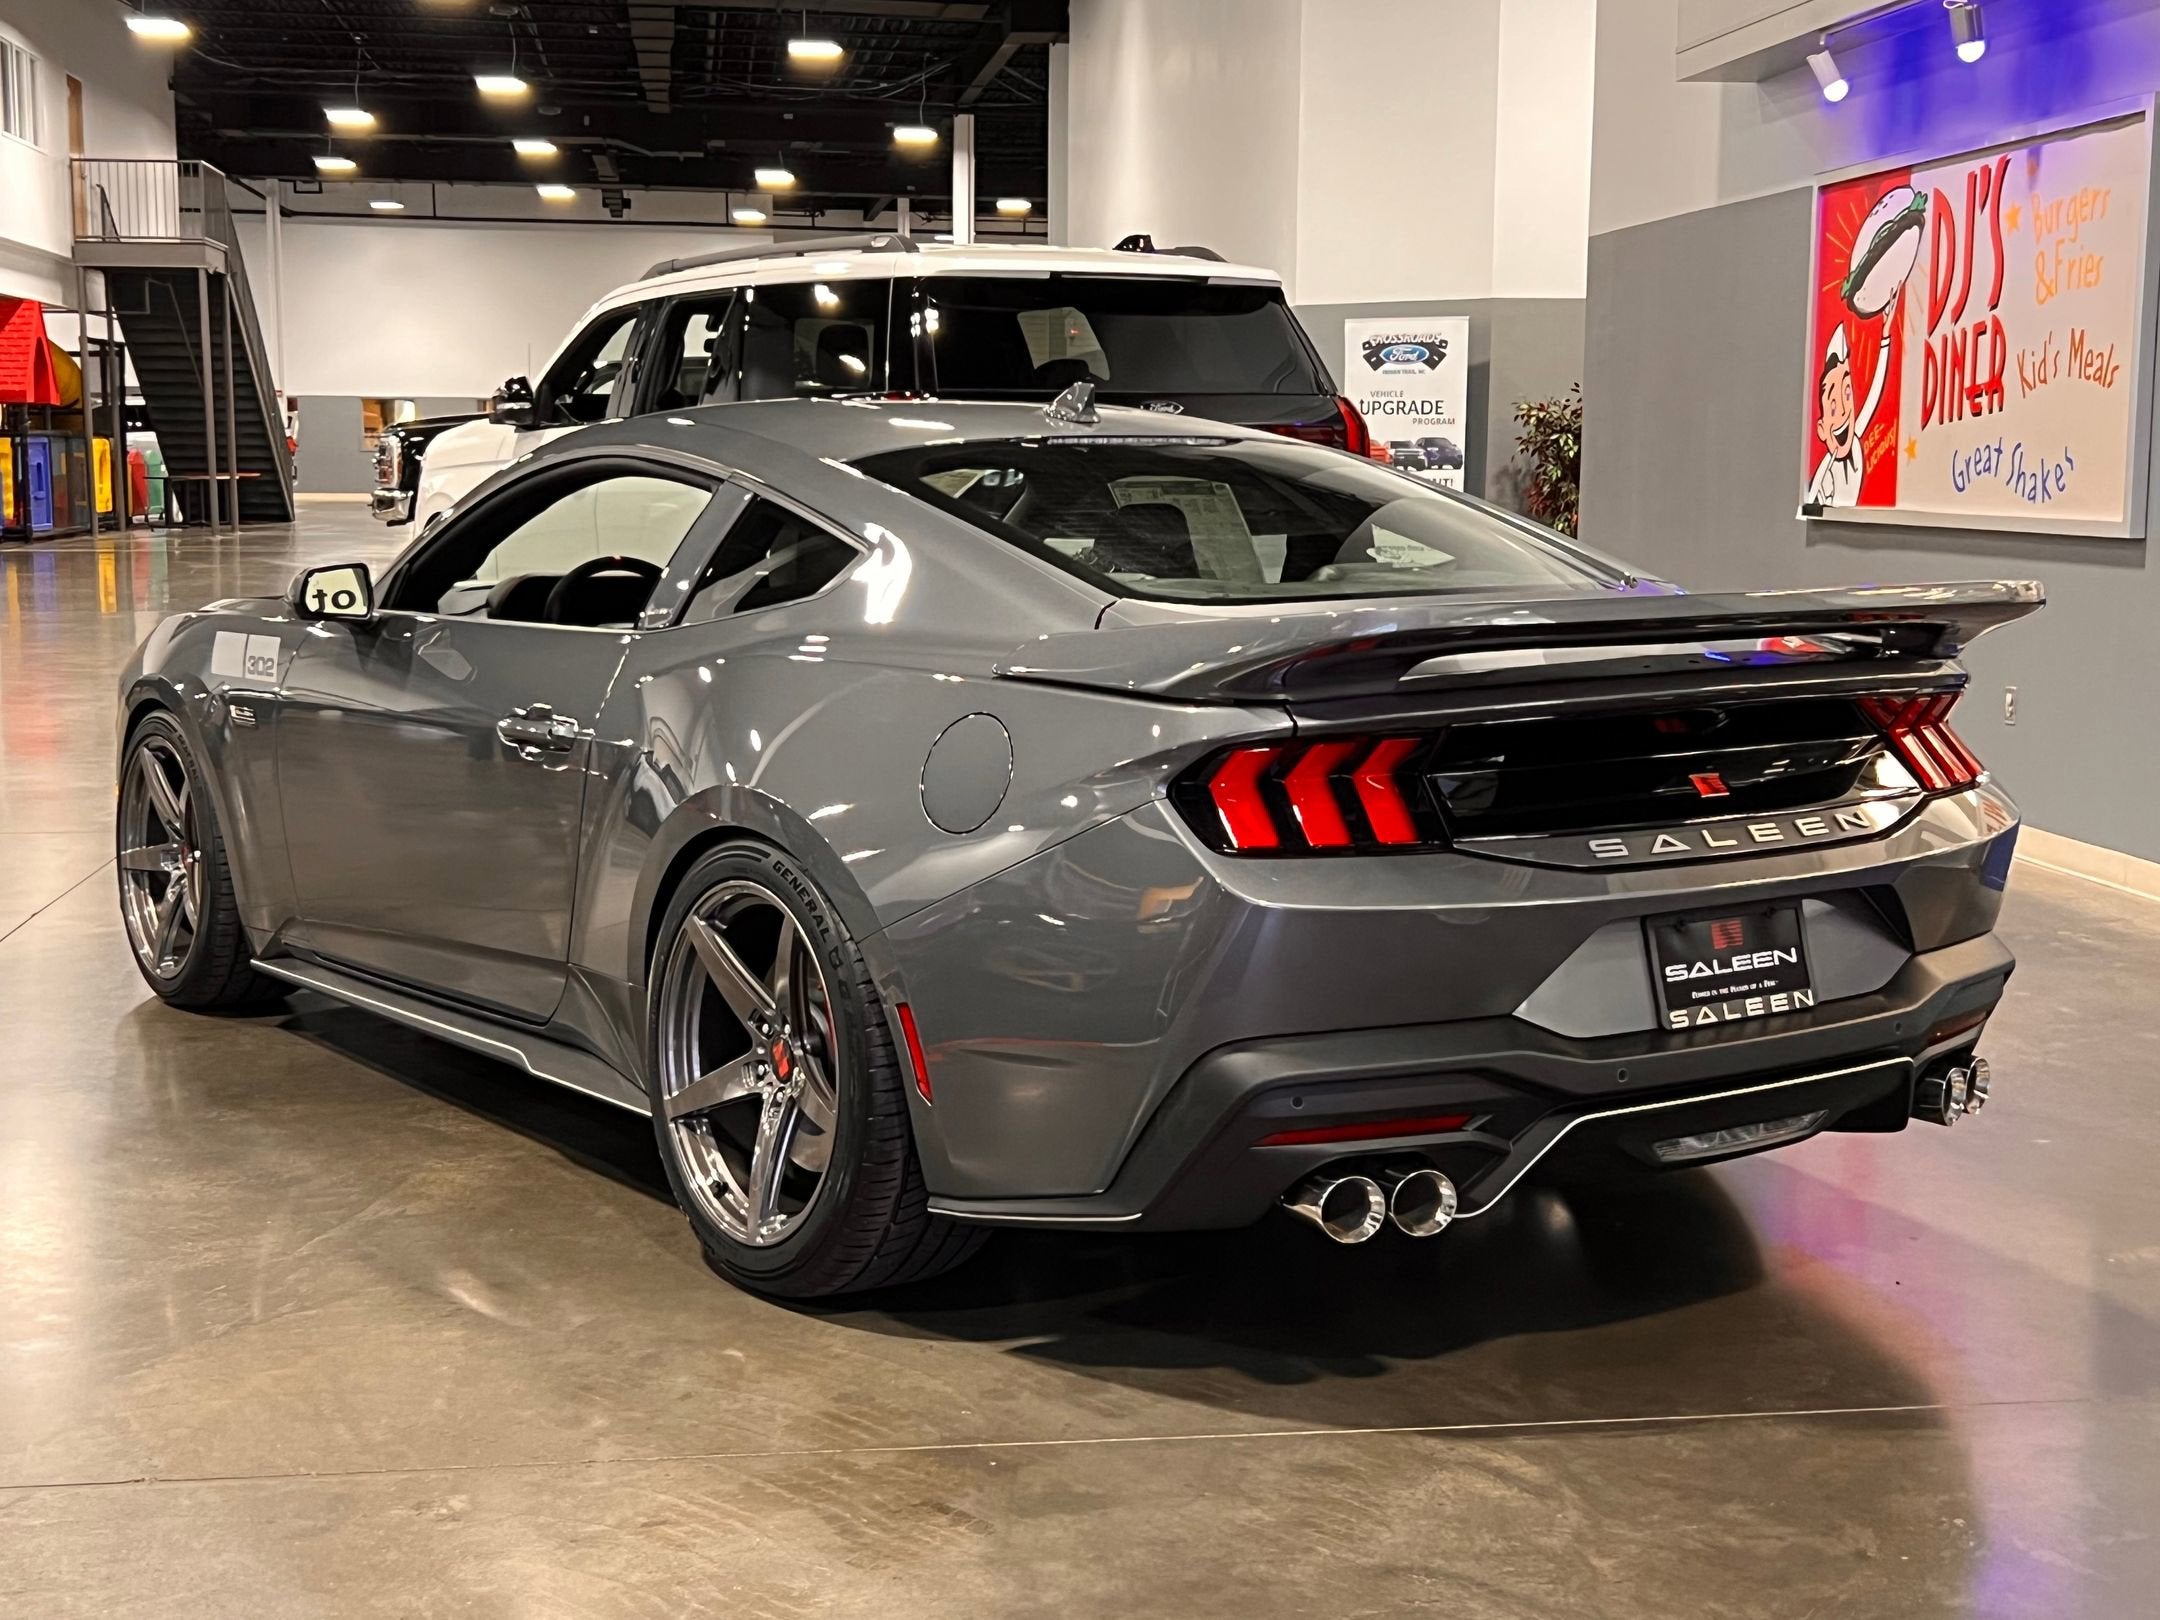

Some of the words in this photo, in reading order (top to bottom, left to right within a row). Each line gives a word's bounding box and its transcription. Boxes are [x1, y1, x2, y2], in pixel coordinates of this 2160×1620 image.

[2031, 187, 2111, 245] Burgers
[1927, 154, 2012, 338] DJ'S
[1389, 346, 1421, 361] Ford
[1921, 314, 2007, 431] DINER
[2017, 330, 2060, 398] Kid's
[2067, 327, 2120, 389] Meals
[1360, 399, 1445, 415] UPGRADE
[1370, 390, 1404, 398] VEHICLE
[1412, 417, 1456, 425] PROGRAM
[1952, 437, 2003, 493] Great
[2005, 442, 2074, 504] Shakes
[247, 655, 275, 678] 302
[1587, 810, 1872, 858] SALEEN
[772, 860, 831, 943] GENERAL
[1664, 947, 1798, 983] SALEEN
[1669, 989, 1815, 1030] SALEEN
